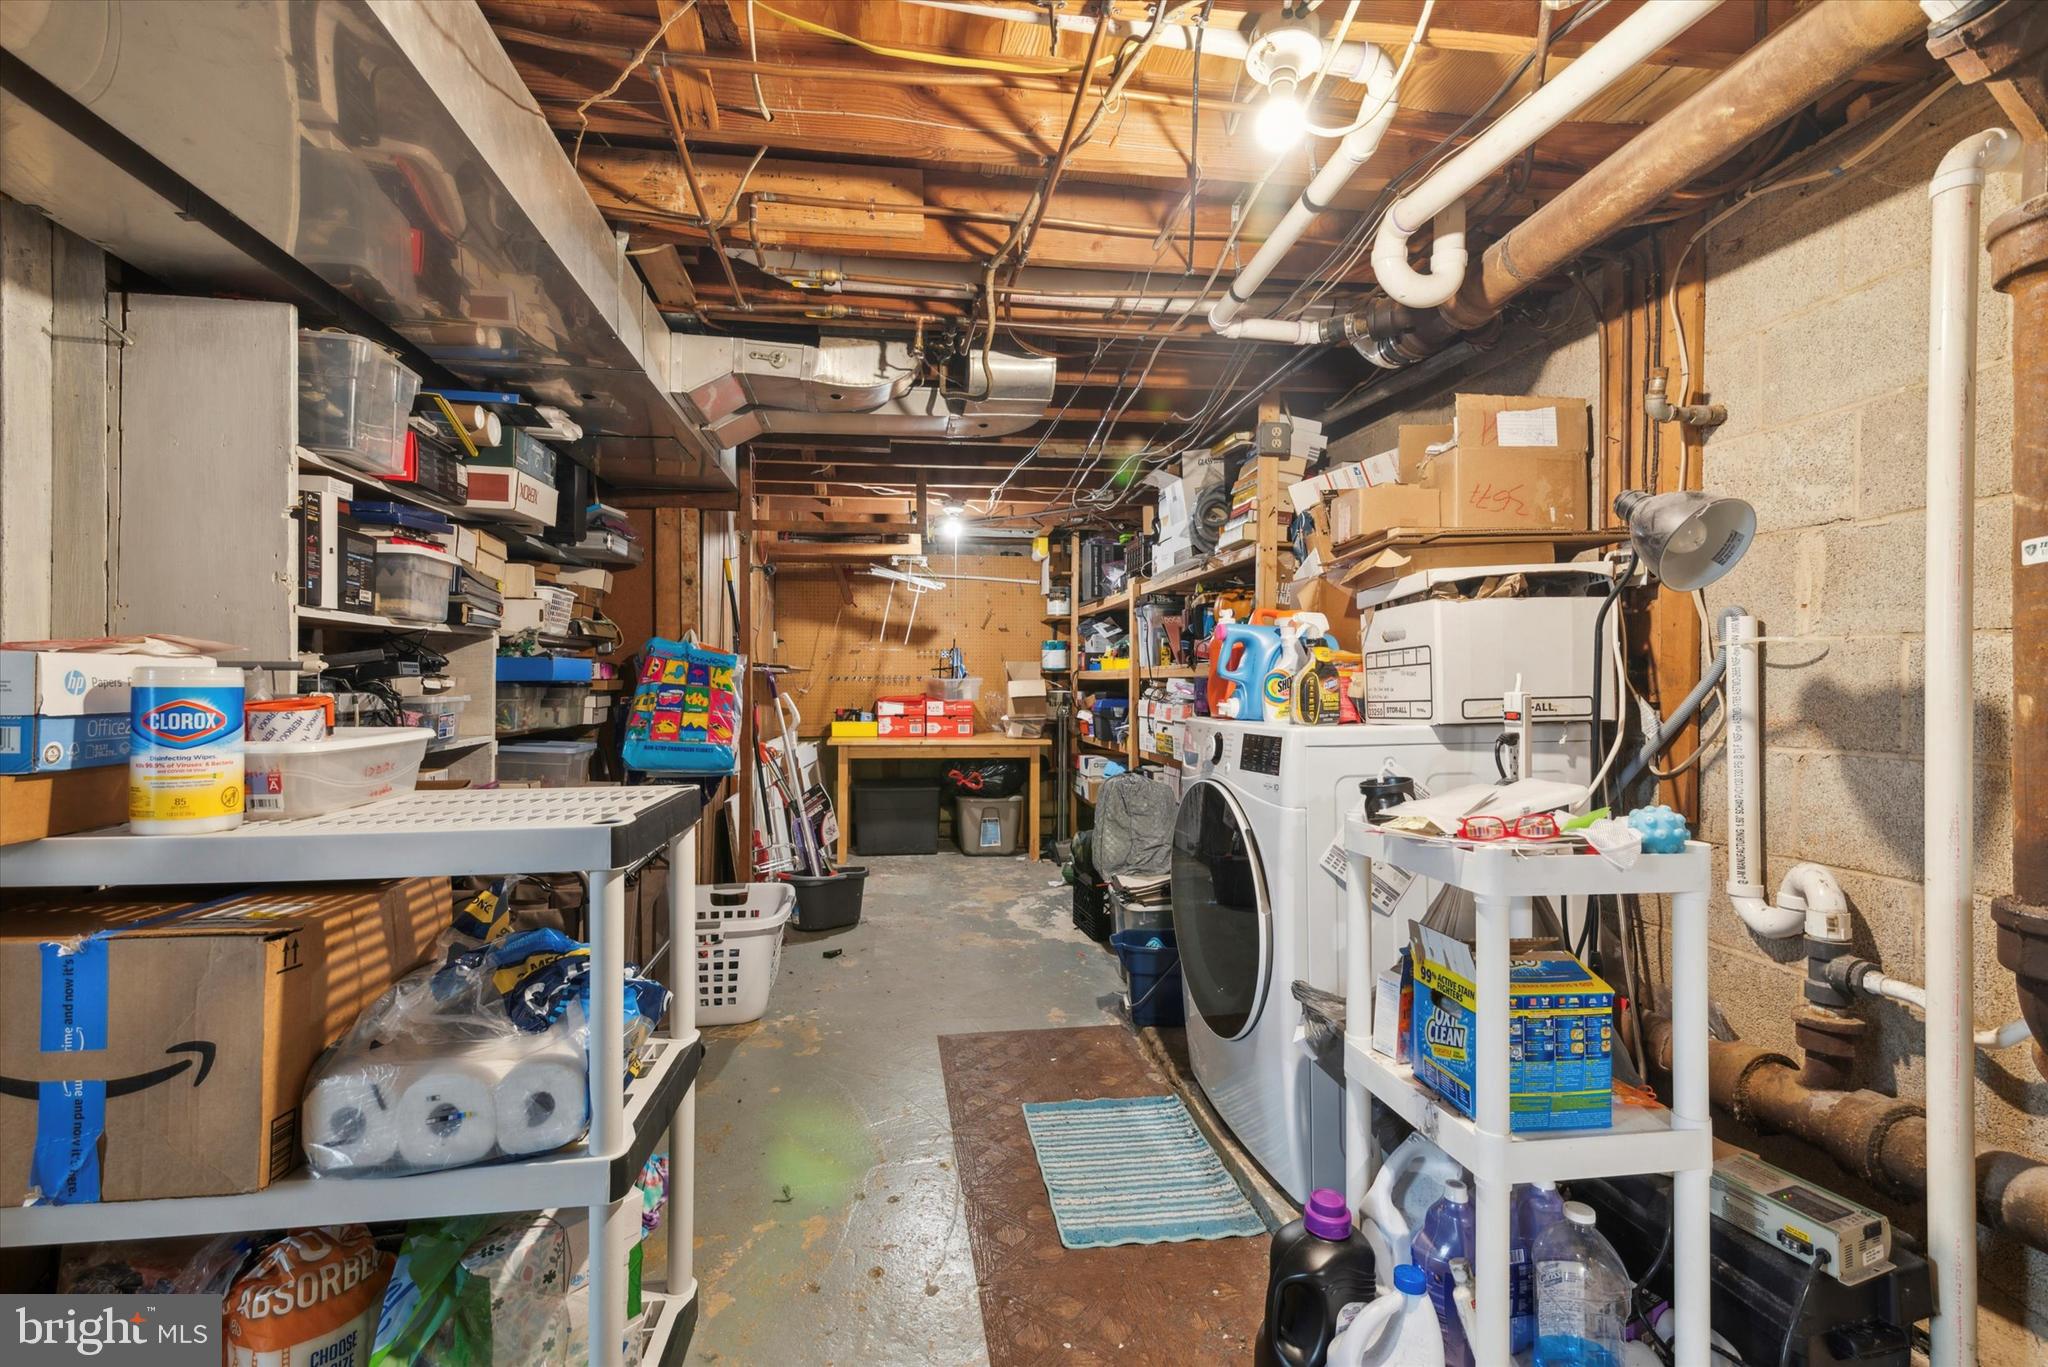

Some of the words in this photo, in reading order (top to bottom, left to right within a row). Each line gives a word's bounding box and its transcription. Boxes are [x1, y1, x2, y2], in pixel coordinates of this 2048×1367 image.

[91, 676, 123, 690] Papers
[149, 712, 217, 730] CLOROX
[149, 754, 192, 762] Disinfecting
[193, 753, 217, 761] Wipes
[174, 797, 187, 806] 85
[1735, 828, 1747, 870] MANUFACTURING
[64, 978, 74, 1002] now
[1437, 973, 1457, 990] ACTIVE
[1457, 983, 1476, 1000] STAIN
[1437, 982, 1463, 1002] FIGHTERS
[62, 1004, 74, 1025] and
[1427, 1019, 1464, 1048] CLEAN
[73, 1098, 85, 1120] and
[71, 1122, 82, 1147] now
[309, 1330, 359, 1367] CHOOSE
